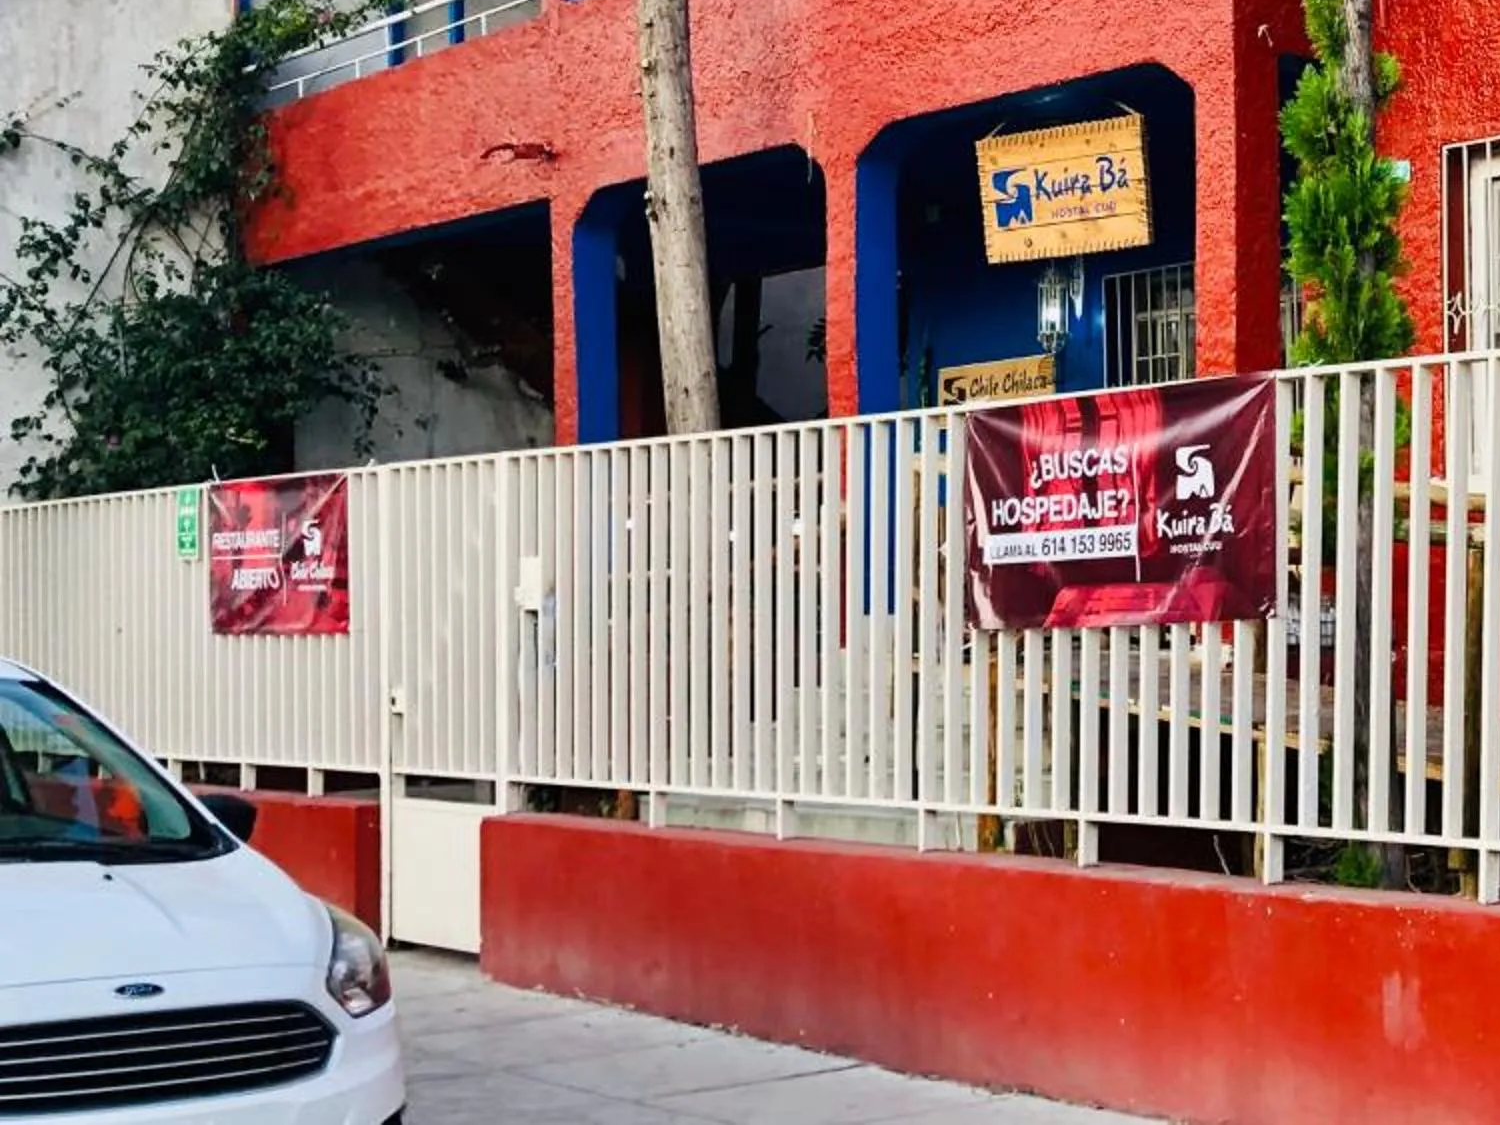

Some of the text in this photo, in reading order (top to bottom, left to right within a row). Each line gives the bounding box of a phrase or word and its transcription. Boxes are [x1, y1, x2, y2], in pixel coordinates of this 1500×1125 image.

[1034, 156, 1129, 201] Kuira Bá
[969, 369, 1048, 397] Chile Chilaca
[1030, 444, 1129, 489] ¿BUSCAS
[991, 488, 1129, 527] HOSPEDAJE?
[1156, 502, 1235, 540] Kuira Bá
[1041, 536, 1066, 557] 614
[1071, 534, 1095, 555] 153
[1099, 531, 1132, 553] 9965
[231, 567, 280, 591] ABIERTO
